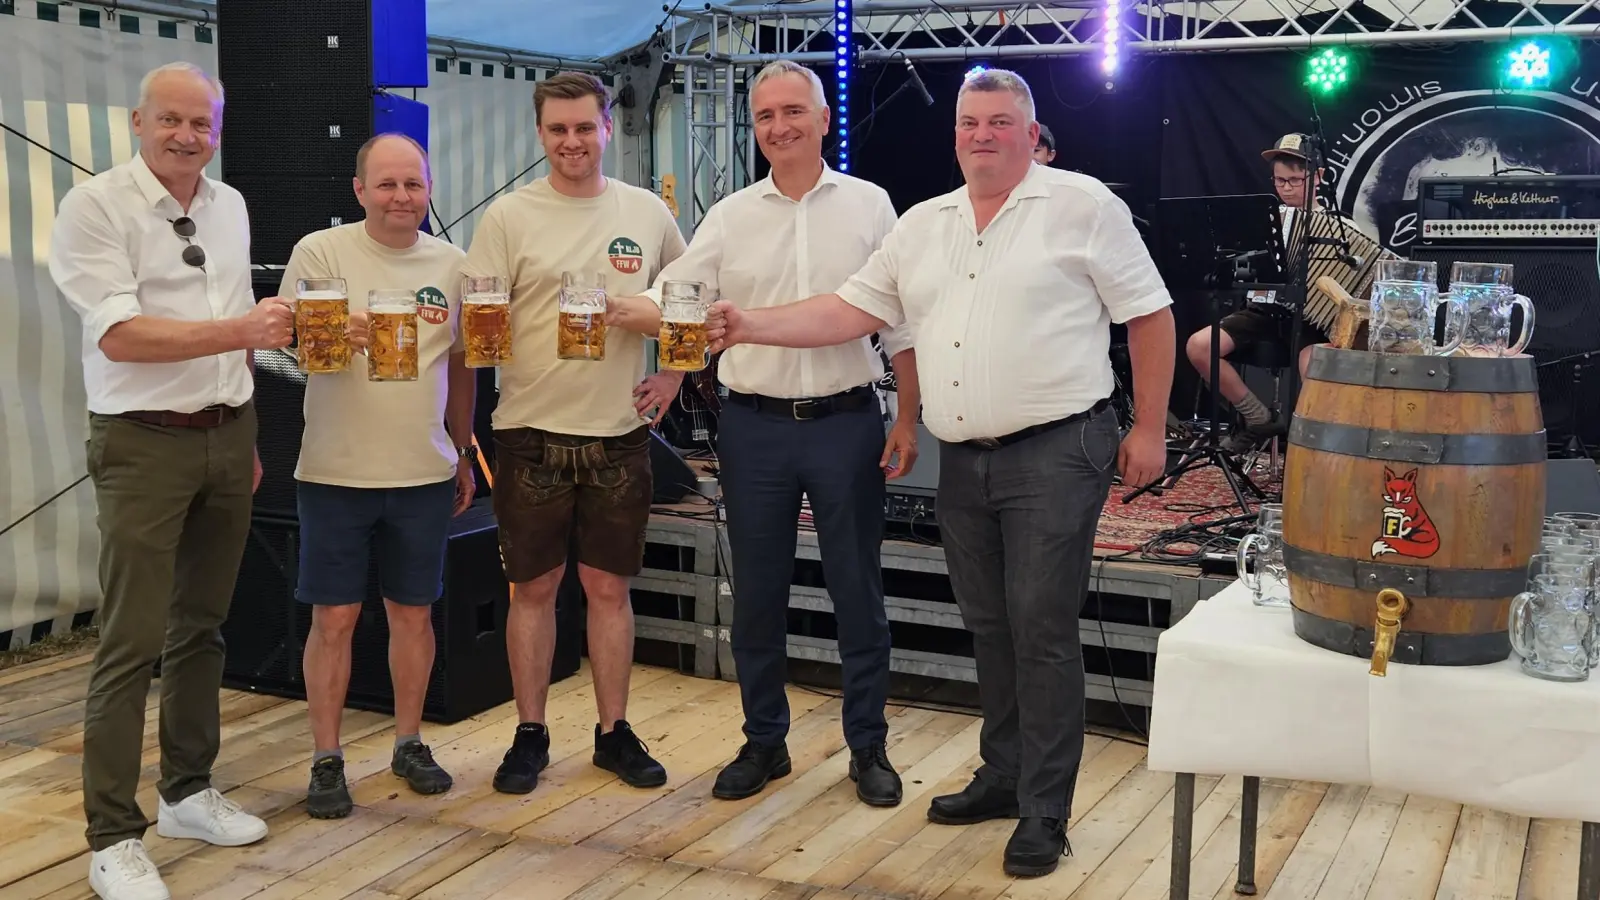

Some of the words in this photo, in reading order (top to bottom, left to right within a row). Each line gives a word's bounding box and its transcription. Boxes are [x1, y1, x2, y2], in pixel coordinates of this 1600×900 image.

[327, 35, 339, 45] HK
[329, 125, 341, 135] HK
[1472, 190, 1509, 210] Hughes
[1510, 192, 1519, 205] &
[616, 259, 630, 269] FFW
[421, 308, 435, 319] FFW
[1386, 518, 1399, 535] F
